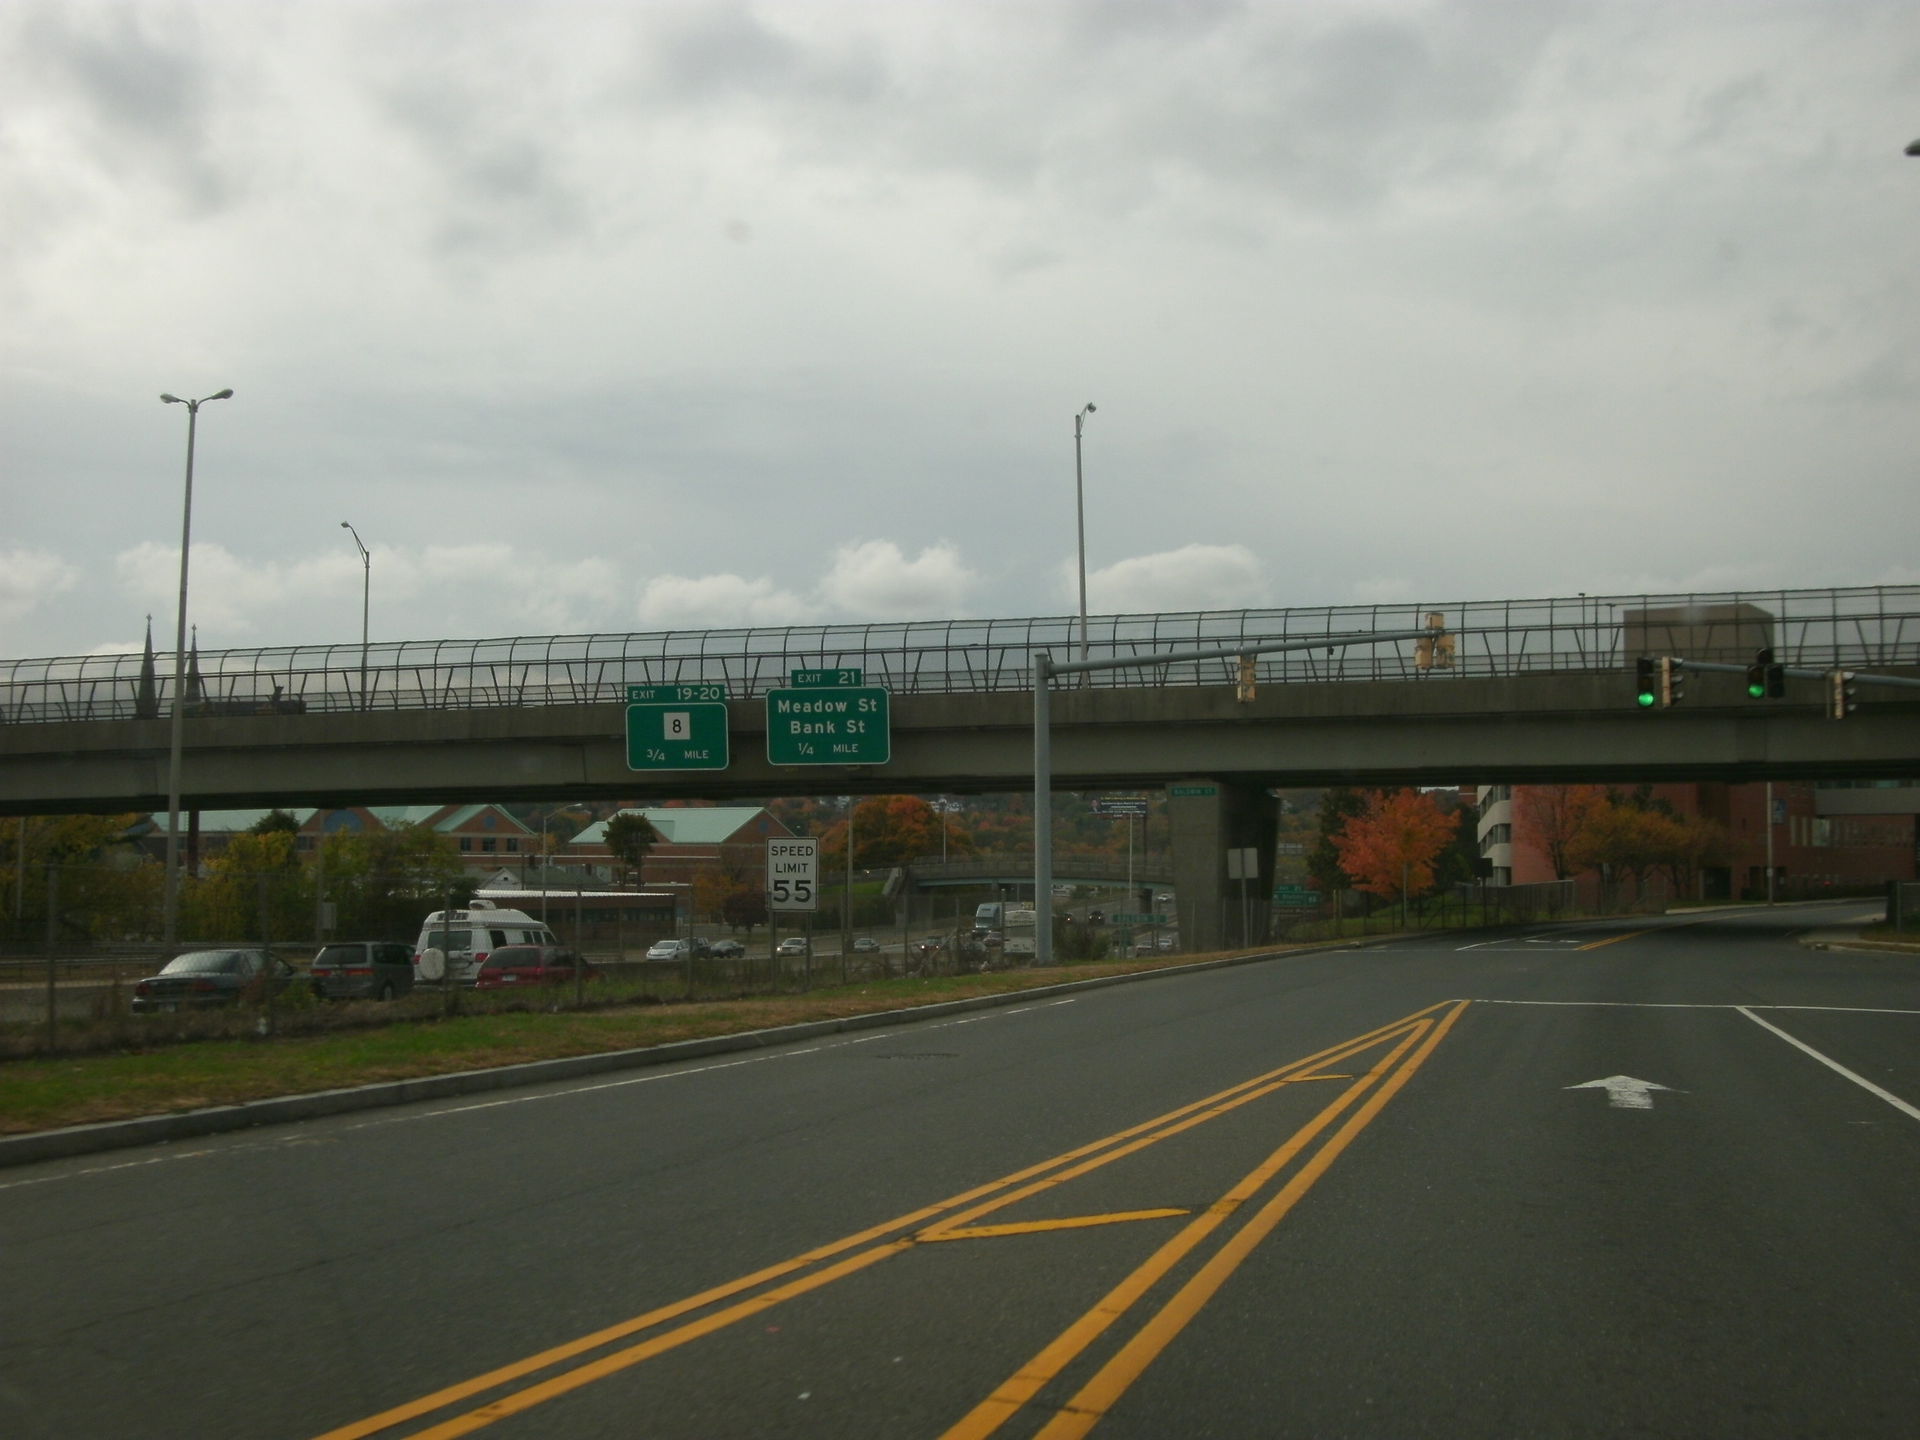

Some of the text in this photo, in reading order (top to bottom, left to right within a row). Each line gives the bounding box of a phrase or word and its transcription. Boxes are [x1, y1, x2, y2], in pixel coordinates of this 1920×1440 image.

[798, 671, 855, 684] EXIT 21
[632, 687, 720, 700] EXIT 19-20
[778, 698, 877, 713] Meadow St
[672, 718, 682, 734] 8
[790, 720, 865, 734] Bank St
[684, 750, 709, 759] MILE
[833, 743, 858, 753] MILE
[771, 846, 814, 856] SPEED
[775, 863, 808, 873] LIMIT
[773, 880, 811, 903] 55
